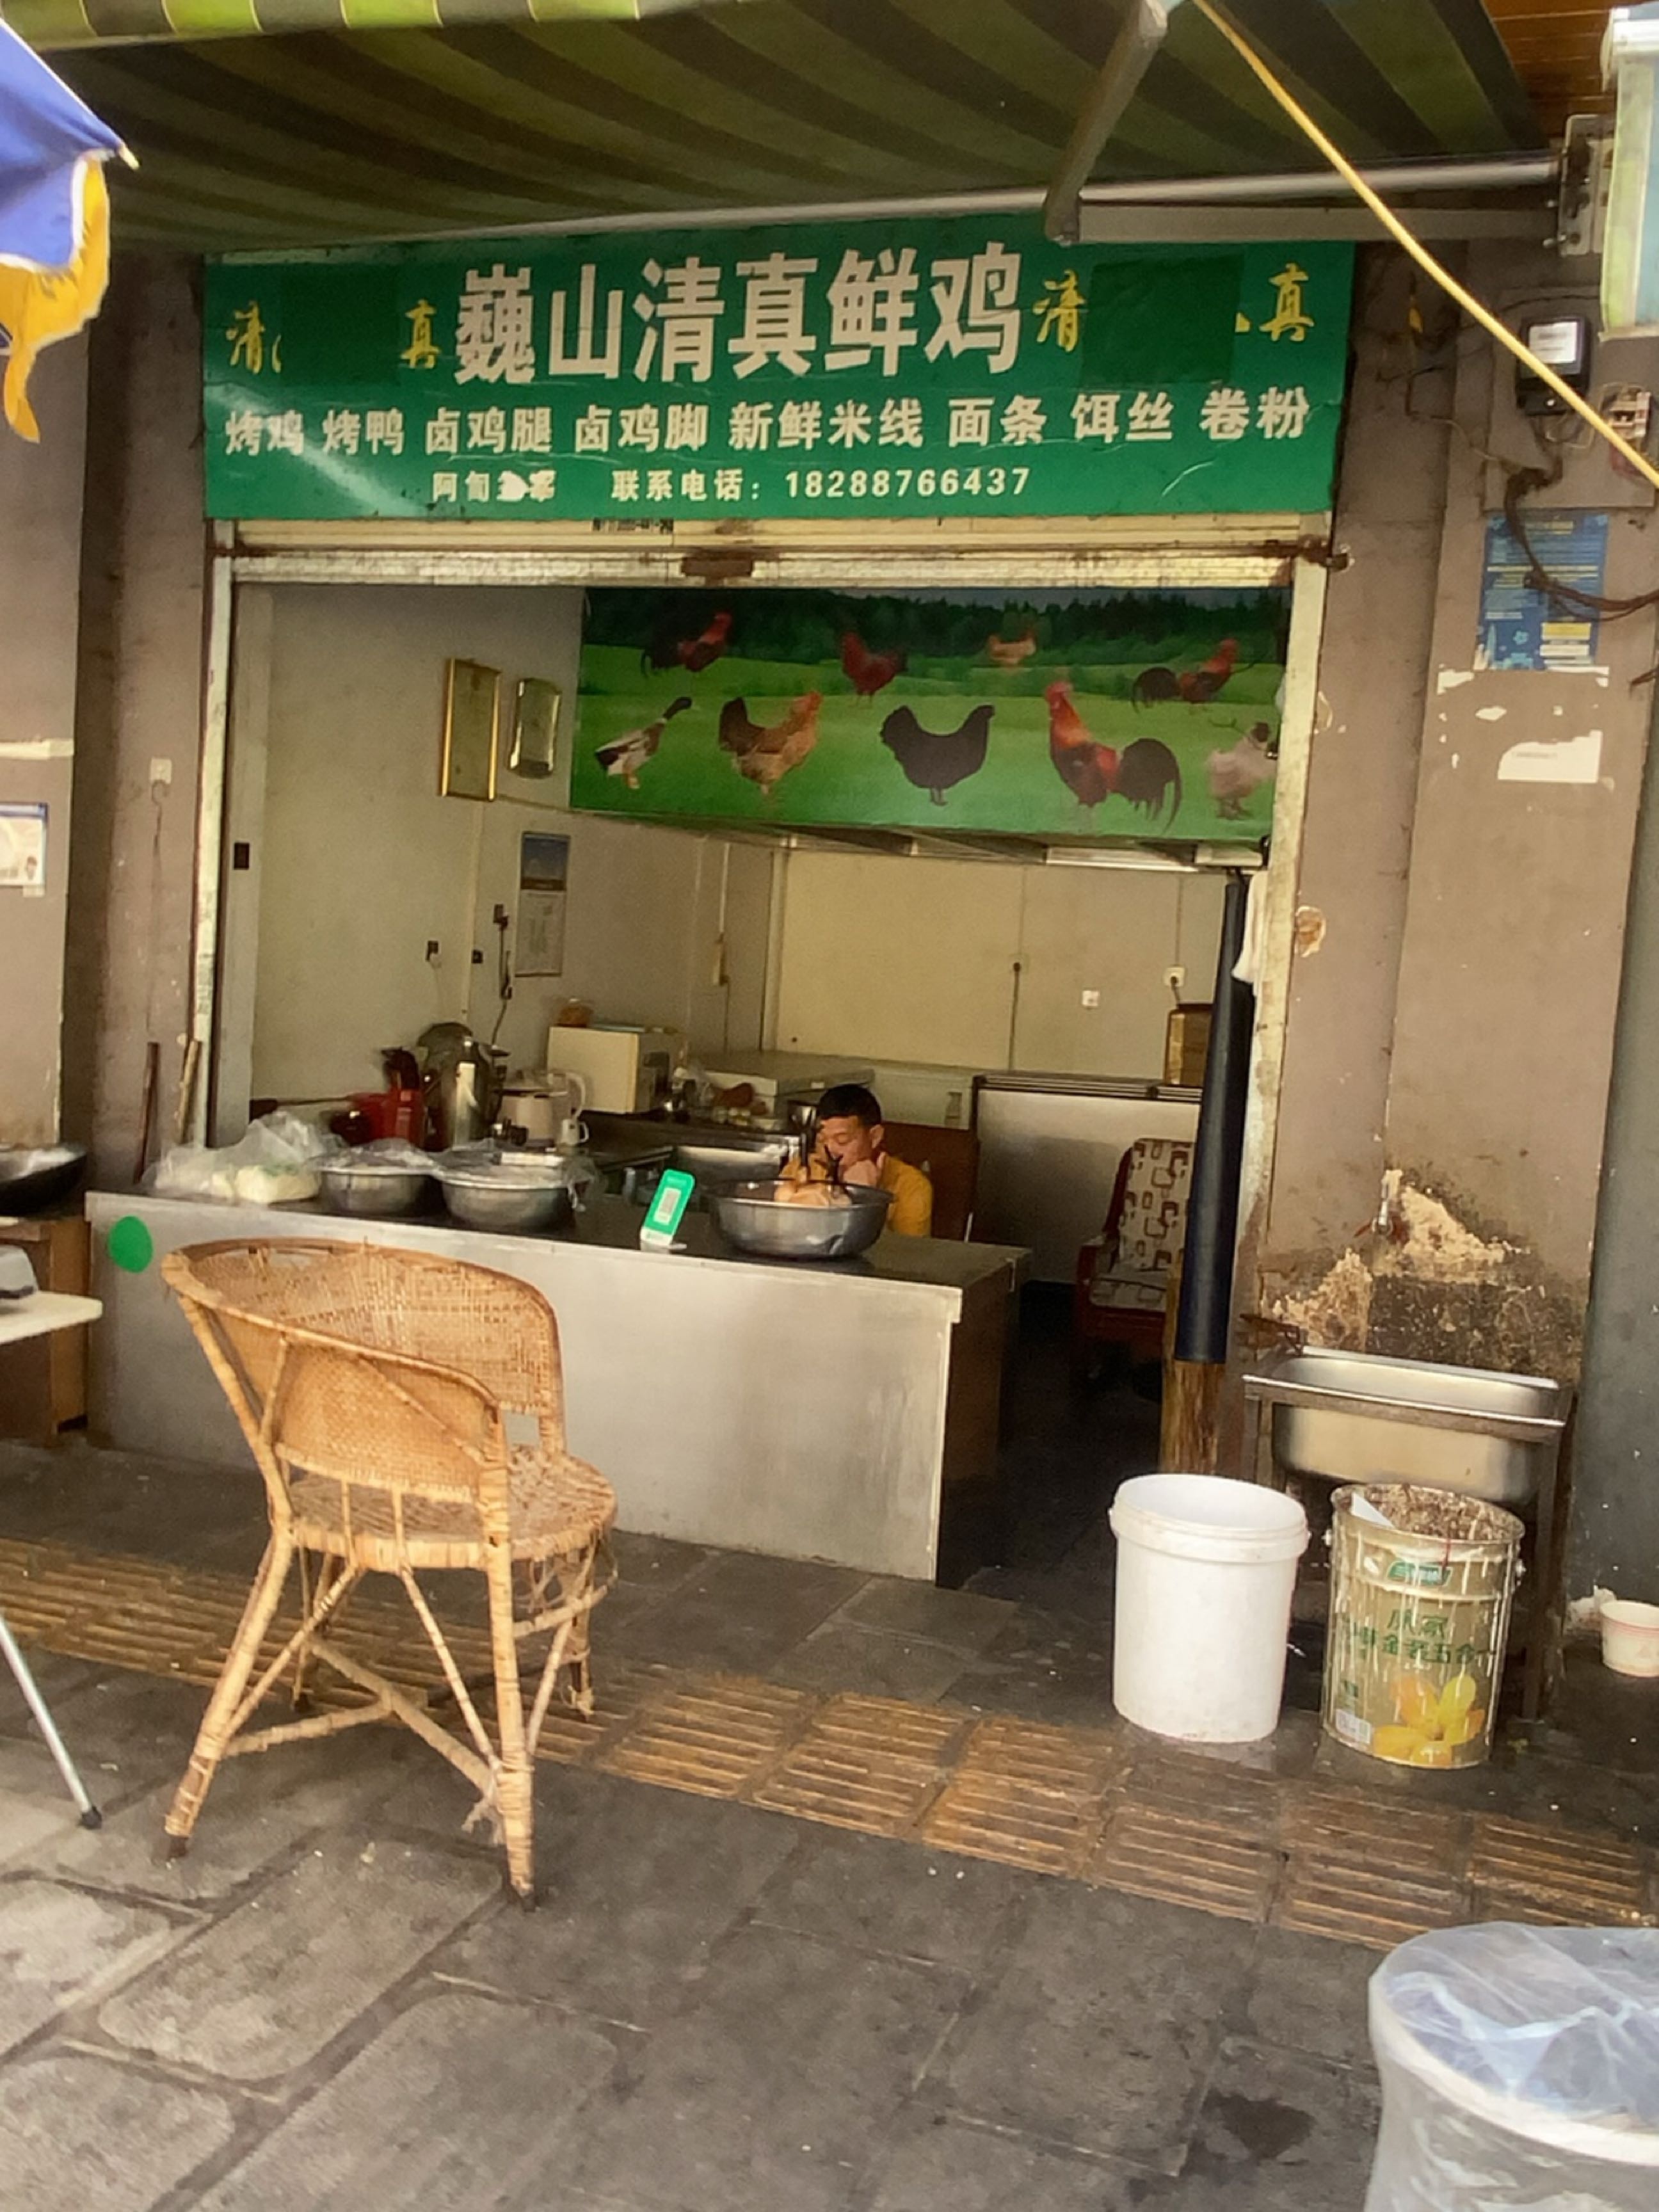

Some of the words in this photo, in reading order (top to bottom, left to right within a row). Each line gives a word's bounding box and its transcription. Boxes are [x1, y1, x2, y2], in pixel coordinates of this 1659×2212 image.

[454, 243, 1022, 384] 巍山清真鲜鸡
[1259, 262, 1314, 342] 真
[225, 411, 305, 457] 烤鸡
[322, 408, 404, 456] 烤鸭
[425, 405, 552, 455] 卤鸡腿
[574, 402, 708, 454] 卤鸡脚
[728, 397, 924, 451] 新鲜米线
[947, 394, 1048, 448] 面条
[1070, 390, 1174, 444] 饵丝
[1199, 385, 1310, 441] 卷粉
[785, 467, 1030, 498] 18288766437
